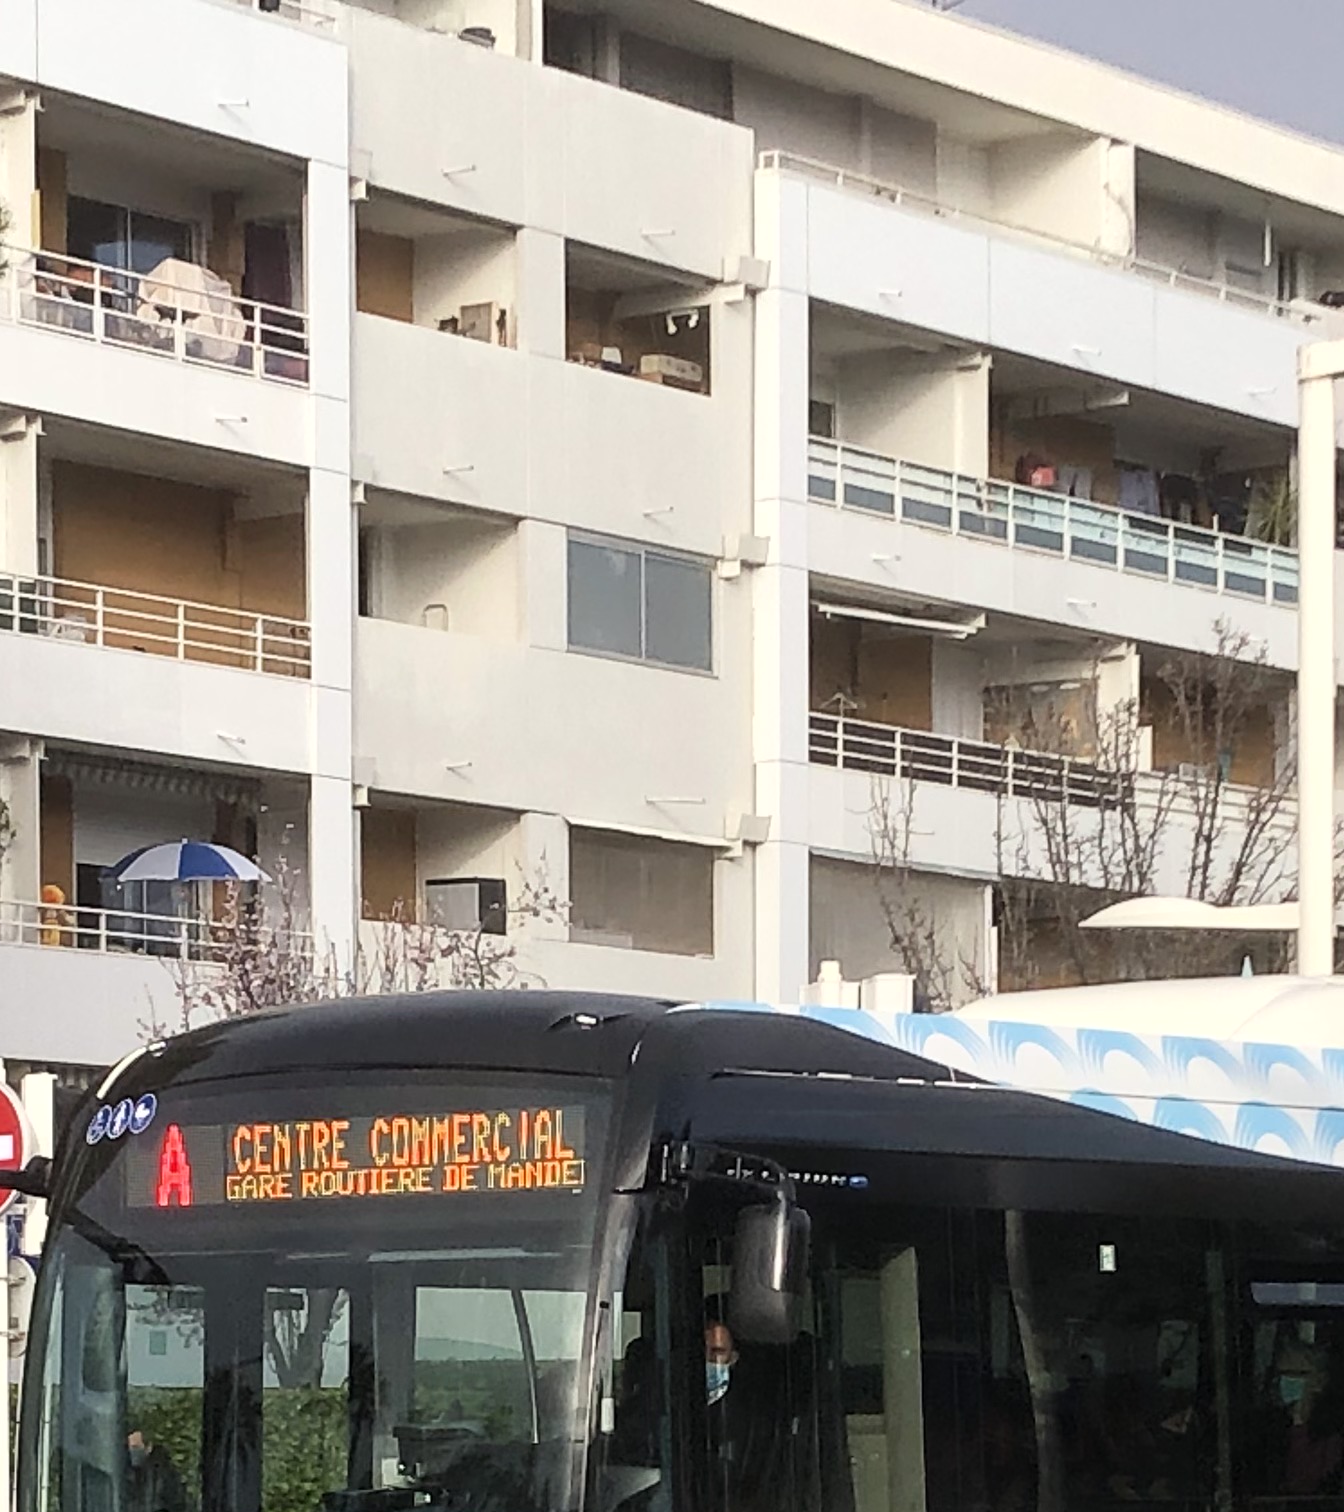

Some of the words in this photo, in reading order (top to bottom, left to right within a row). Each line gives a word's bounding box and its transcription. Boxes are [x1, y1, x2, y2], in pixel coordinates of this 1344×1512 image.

[157, 1122, 193, 1207] A
[233, 1120, 351, 1174] CENTRE
[369, 1109, 575, 1167] COMMERCIAL
[226, 1173, 293, 1200] GARE
[301, 1165, 433, 1199] ROUTIERE
[441, 1164, 480, 1190] DE
